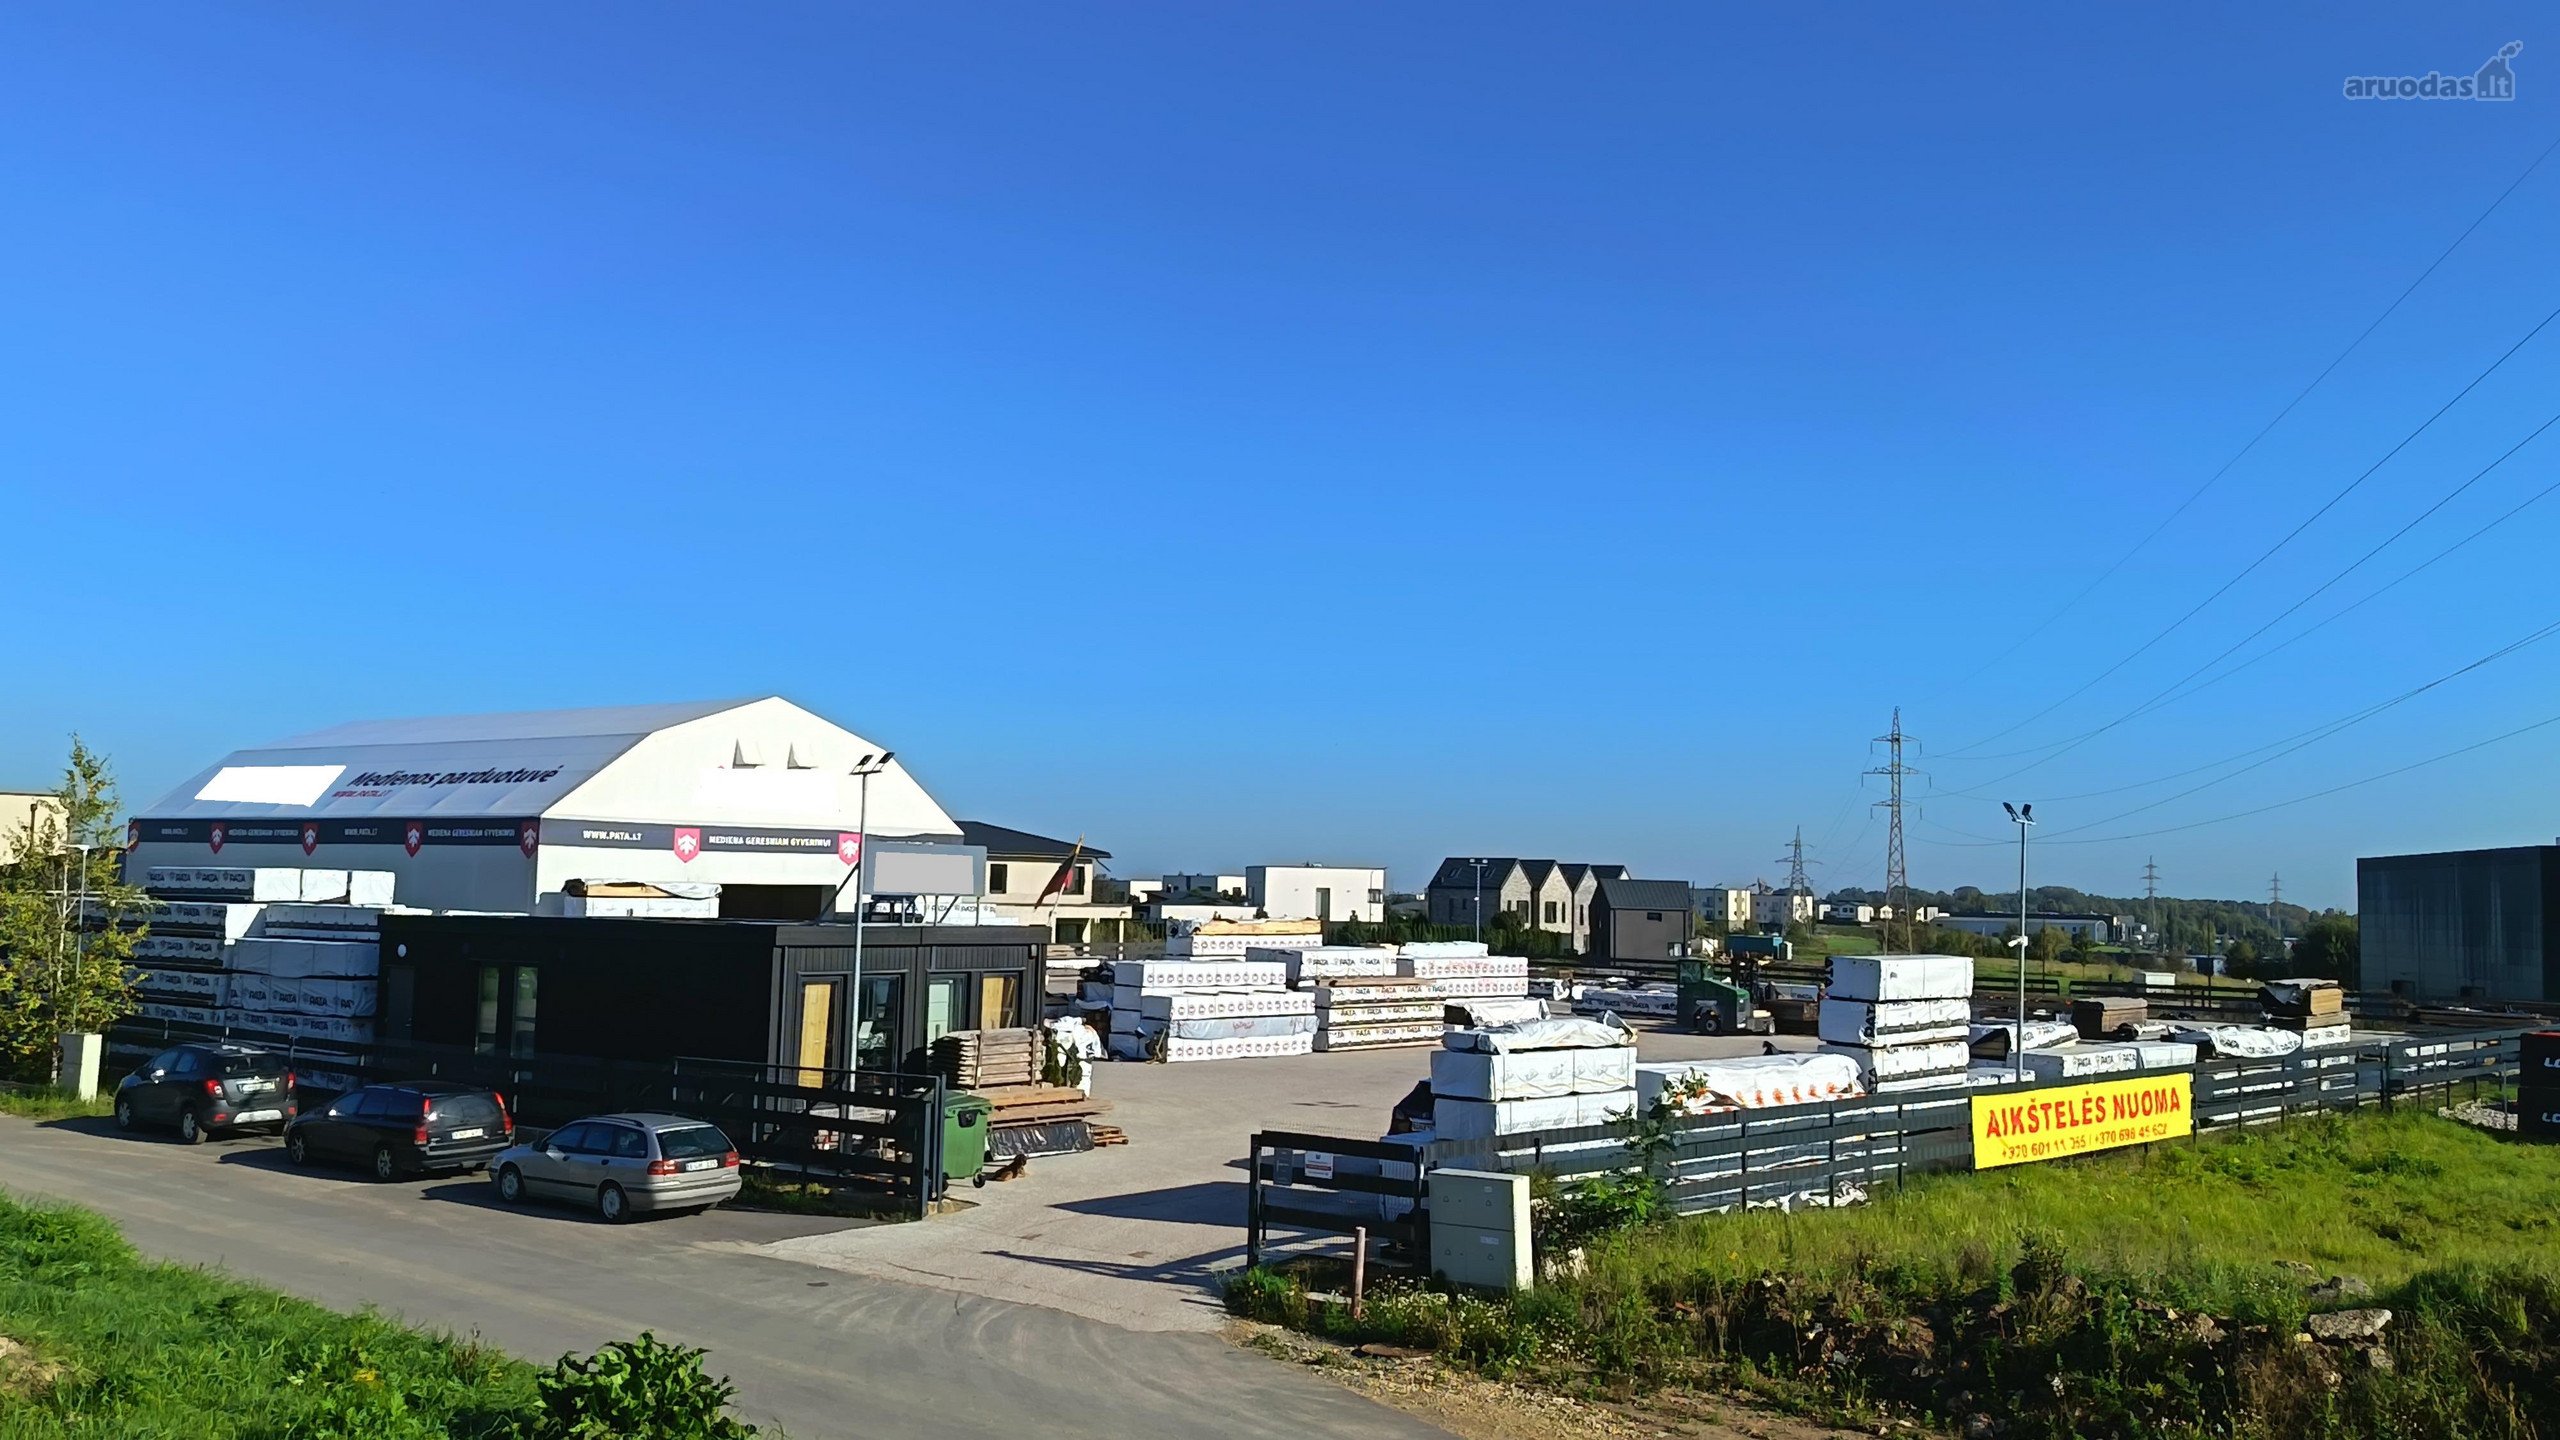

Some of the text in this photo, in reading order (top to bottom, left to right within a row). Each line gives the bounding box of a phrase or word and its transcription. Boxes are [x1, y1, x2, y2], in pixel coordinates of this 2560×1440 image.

[347, 765, 564, 788] Medienos parduotuvė
[583, 830, 643, 842] WWW.PATA.LT
[1986, 1087, 2180, 1138] AIKŠTELĖS NUOMA
[2031, 1142, 2051, 1156] 601
[2094, 1132, 2117, 1145] +370
